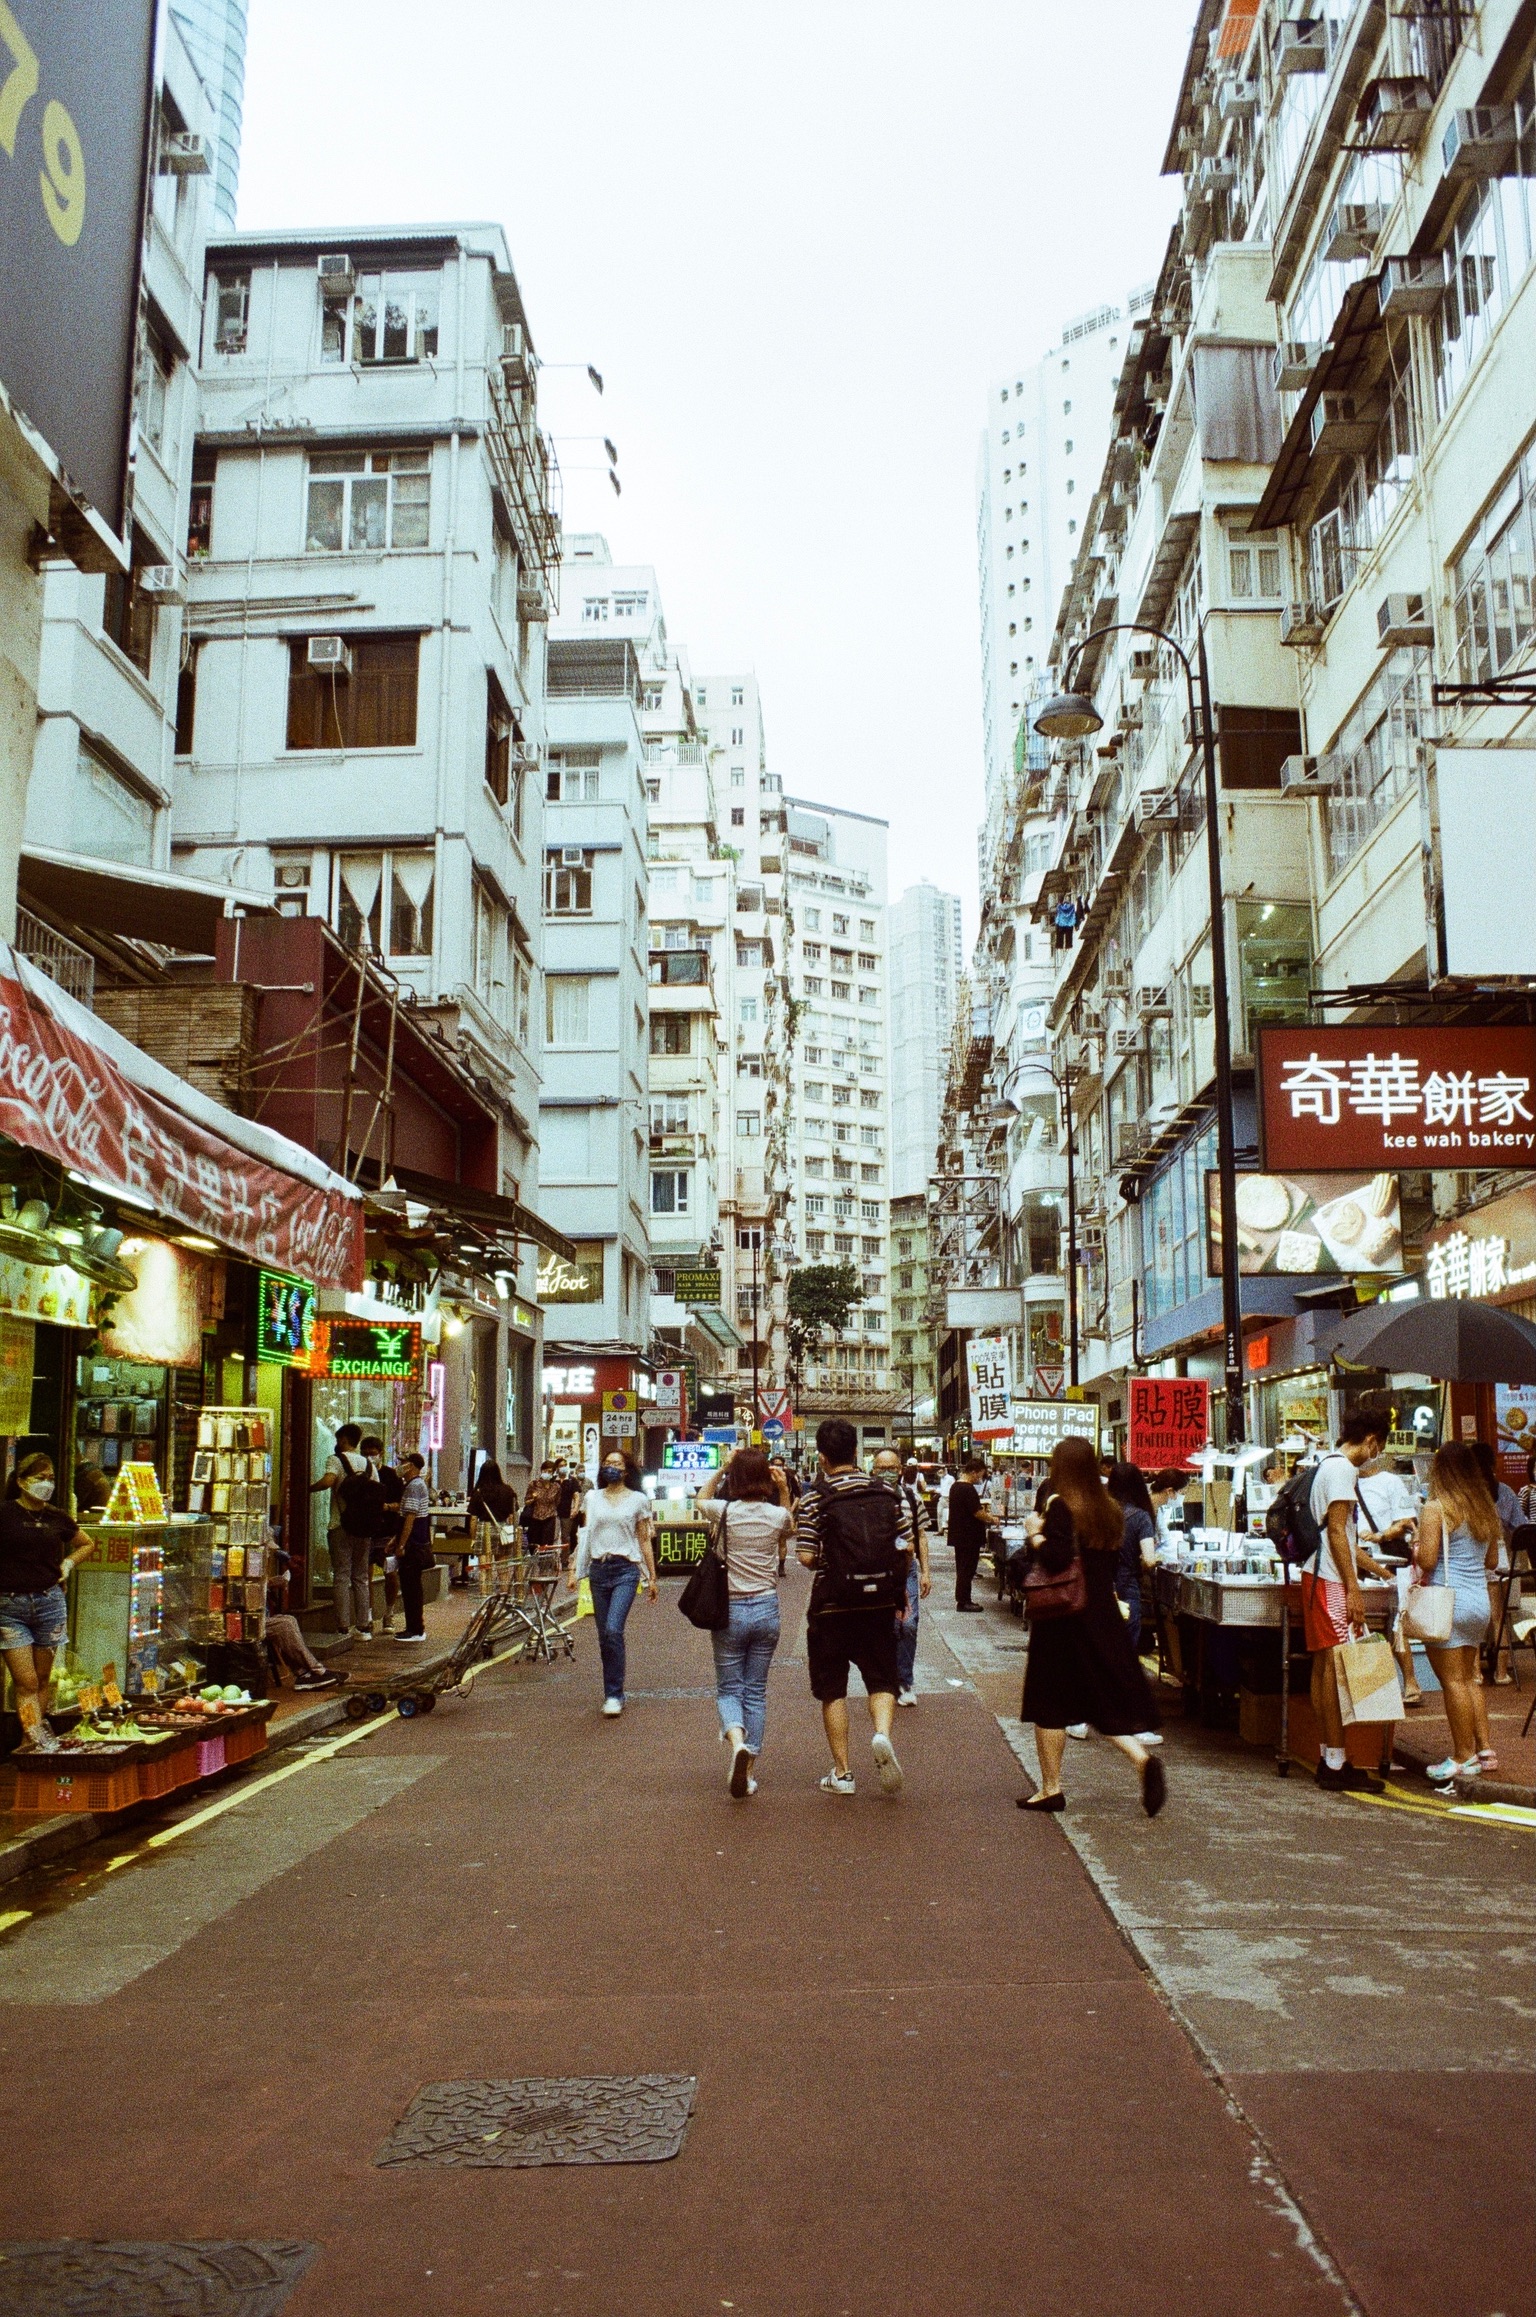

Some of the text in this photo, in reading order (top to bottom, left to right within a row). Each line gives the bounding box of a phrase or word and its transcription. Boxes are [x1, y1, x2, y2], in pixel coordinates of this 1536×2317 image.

[1280, 1053, 1534, 1126] 奇華餅家
[1384, 1130, 1535, 1149] kee wah bakery
[1427, 1230, 1507, 1299] 奇華餅家
[549, 1263, 590, 1294] Foot
[976, 1362, 1009, 1421] 貼膜
[606, 1414, 632, 1422] 24 hrs
[1063, 1407, 1094, 1421] iPad
[1133, 1384, 1204, 1430] 貼膜
[608, 1425, 630, 1434] 全日
[1062, 1424, 1095, 1437] Glass
[684, 1472, 696, 1482] 12
[660, 1532, 706, 1562] 貼膜
